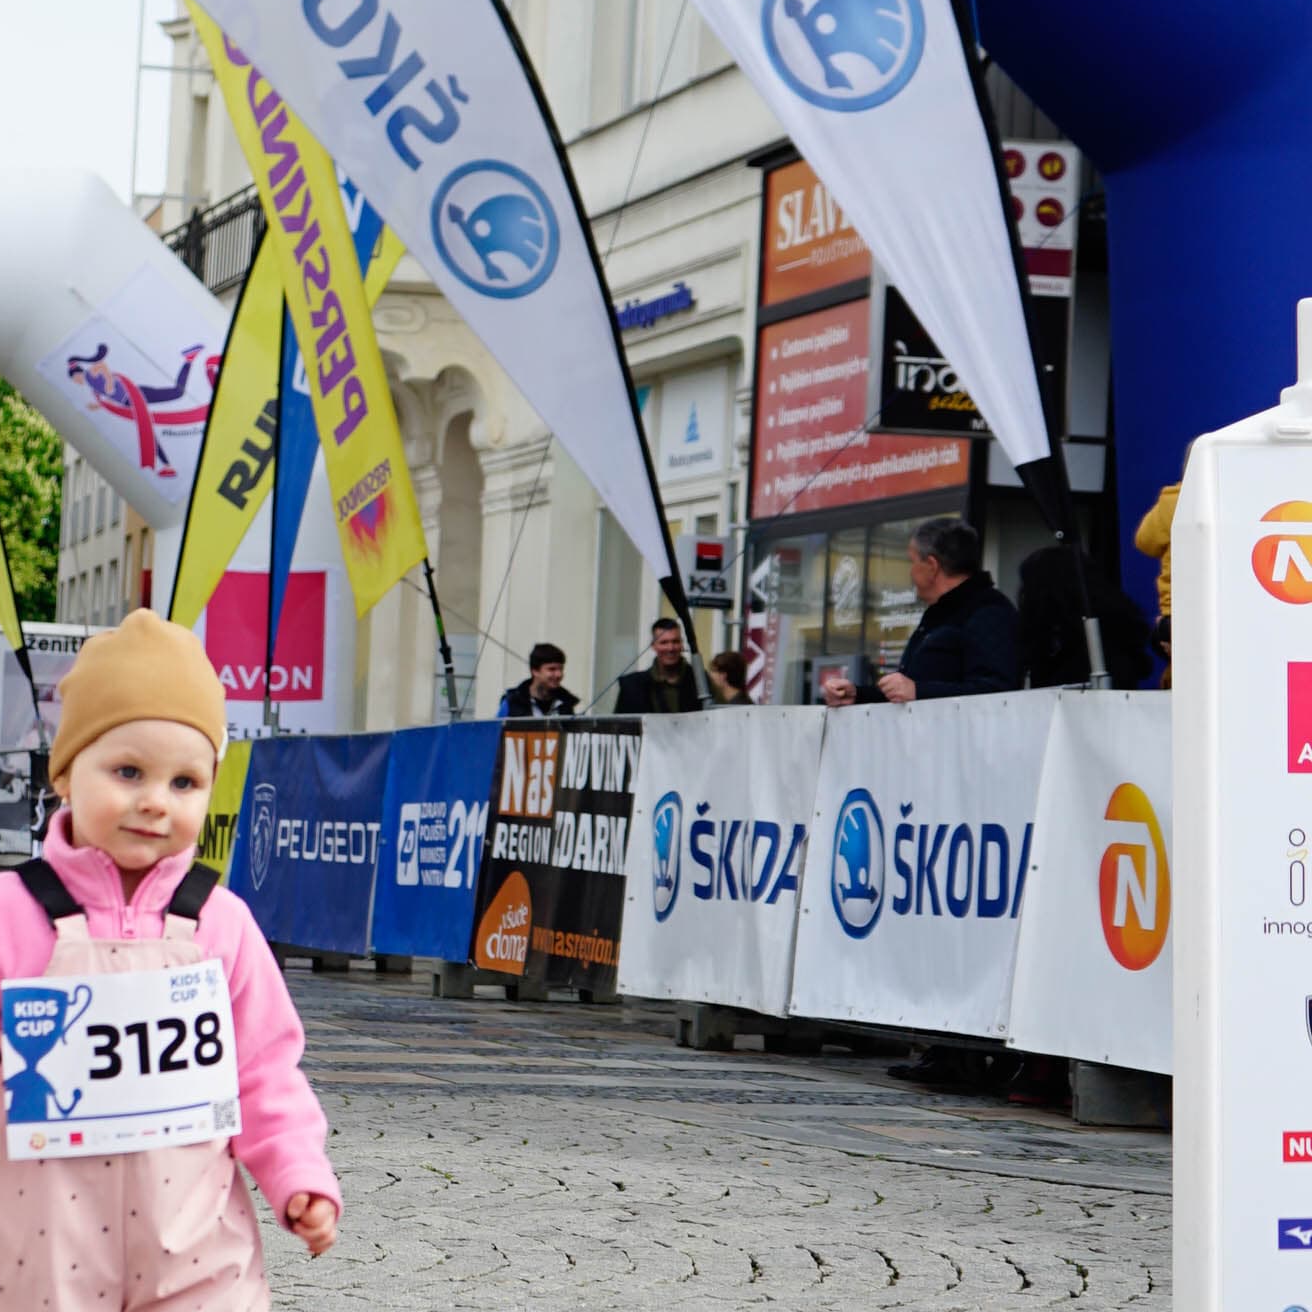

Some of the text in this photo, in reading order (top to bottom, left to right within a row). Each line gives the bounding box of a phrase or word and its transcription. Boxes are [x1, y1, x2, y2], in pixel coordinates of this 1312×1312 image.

[219, 665, 313, 692] AVON
[500, 735, 560, 817] Náš
[561, 732, 641, 794] NOVINY
[276, 819, 382, 865] PEUGEOT
[492, 822, 552, 865] REGION
[551, 810, 628, 876] ZDARM
[170, 974, 201, 989] KIDS
[171, 989, 198, 1003] CUP
[13, 1000, 224, 1081] KIDS 3128
[15, 1019, 56, 1038] CUP
